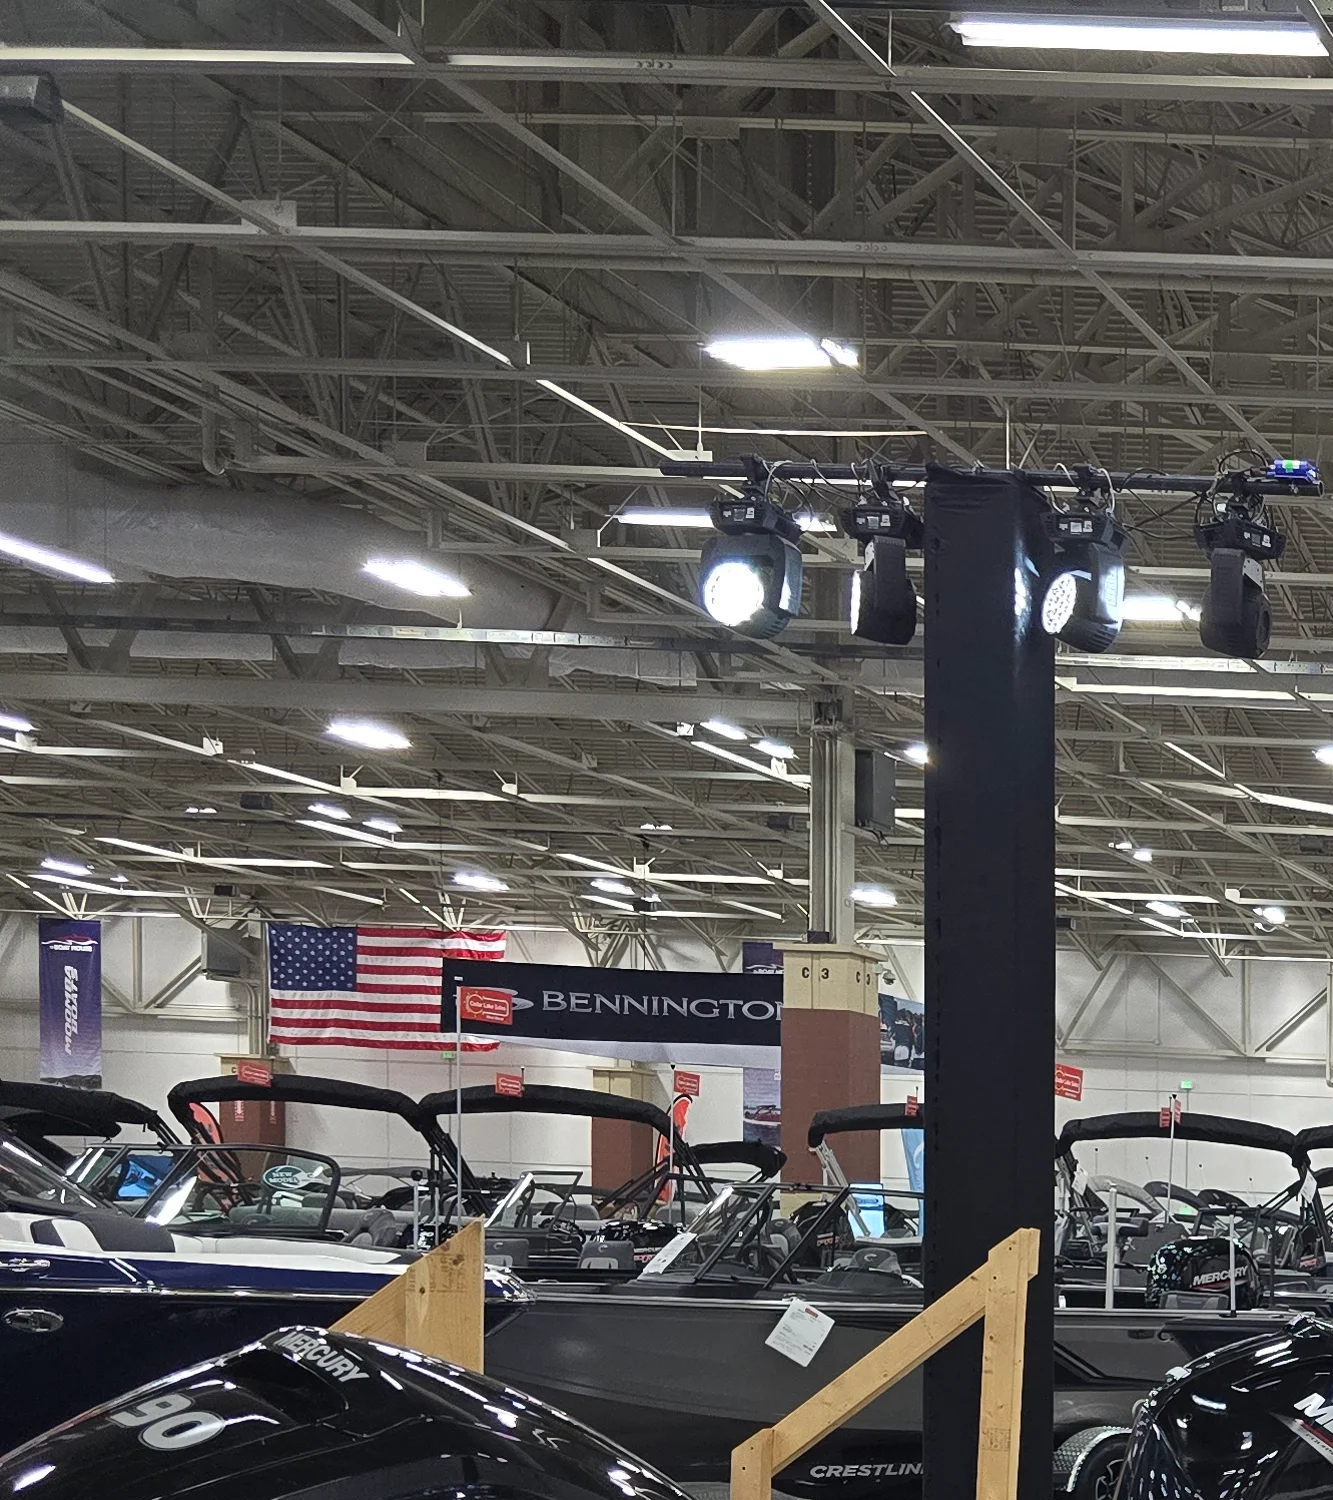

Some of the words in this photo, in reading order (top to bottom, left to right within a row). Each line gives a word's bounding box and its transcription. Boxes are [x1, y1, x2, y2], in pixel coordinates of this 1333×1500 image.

[800, 966, 810, 979] C
[821, 968, 829, 980] 3
[273, 1331, 369, 1383] MERCURY
[109, 1393, 227, 1450] 90
[809, 1462, 923, 1478] CRESTLIN
